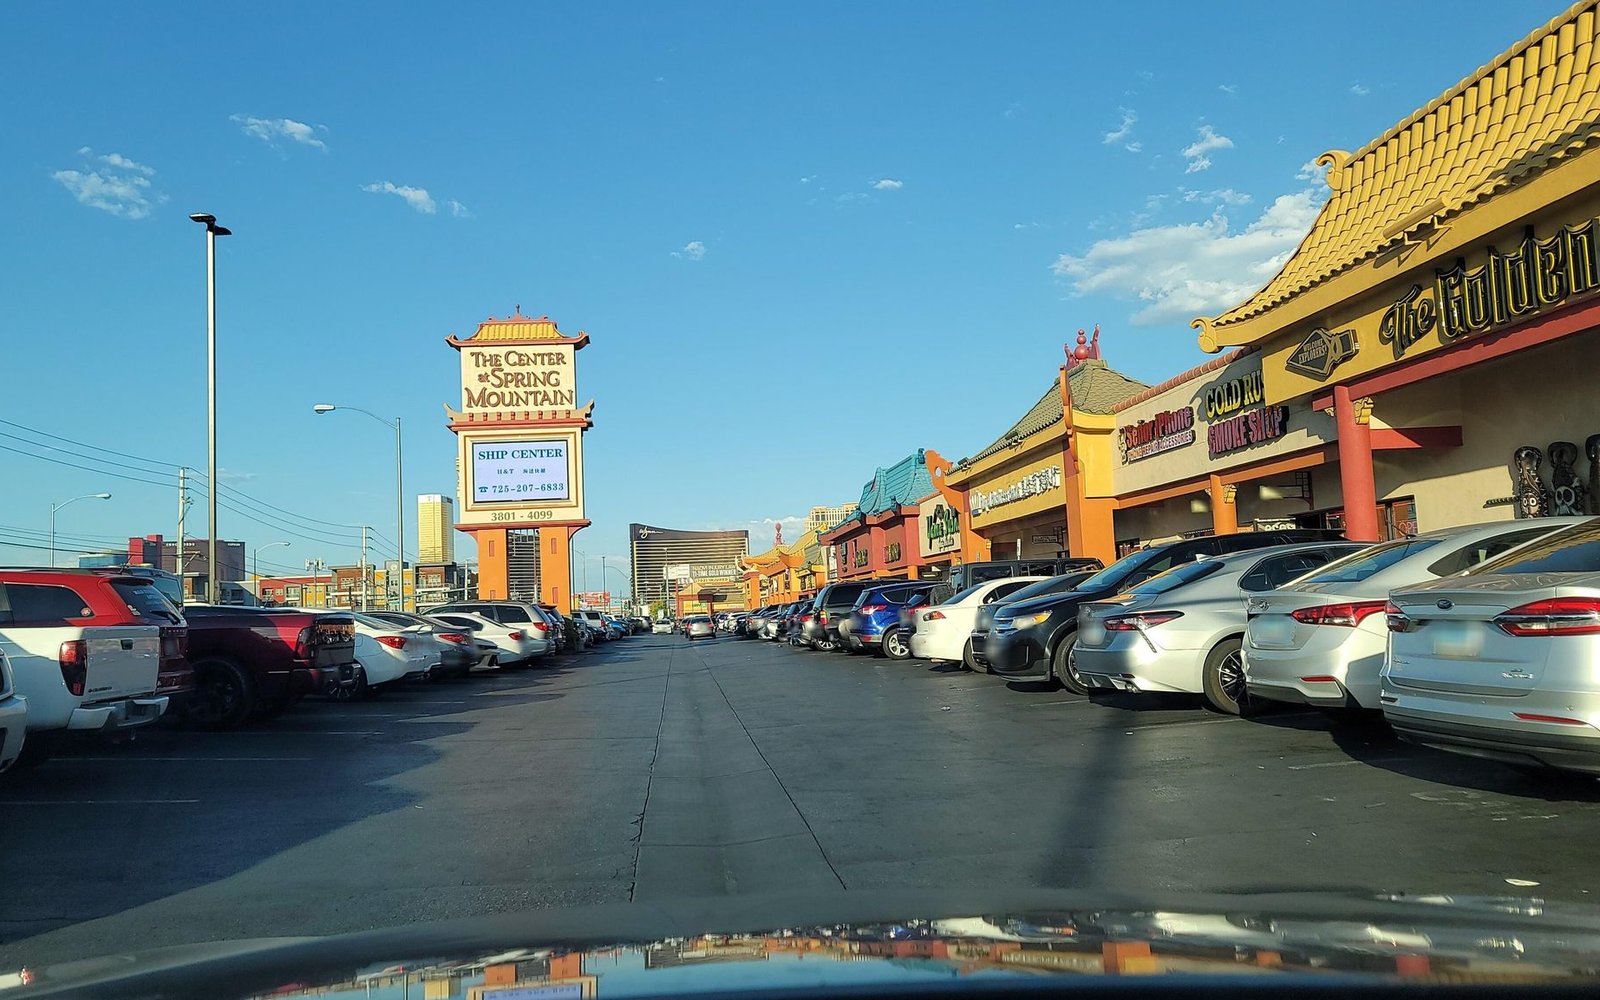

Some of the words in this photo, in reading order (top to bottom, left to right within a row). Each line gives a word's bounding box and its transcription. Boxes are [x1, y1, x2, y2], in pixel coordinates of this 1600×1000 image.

[1380, 284, 1436, 359] The
[1436, 217, 1600, 345] Golden
[470, 351, 502, 367] THE
[504, 350, 567, 367] CENTER
[478, 372, 490, 383] at
[491, 368, 560, 388] SPRING
[464, 386, 574, 409] MOUNTAIN
[1205, 379, 1241, 419] GOLD
[1242, 370, 1265, 406] RU
[1208, 415, 1248, 455] SMOKE
[1248, 405, 1284, 444] SHOP
[478, 450, 508, 460] SHIP
[511, 448, 563, 459] CENTER
[492, 482, 564, 493] 725-207-6833
[491, 511, 516, 522] 3801
[527, 510, 553, 520] 4099
